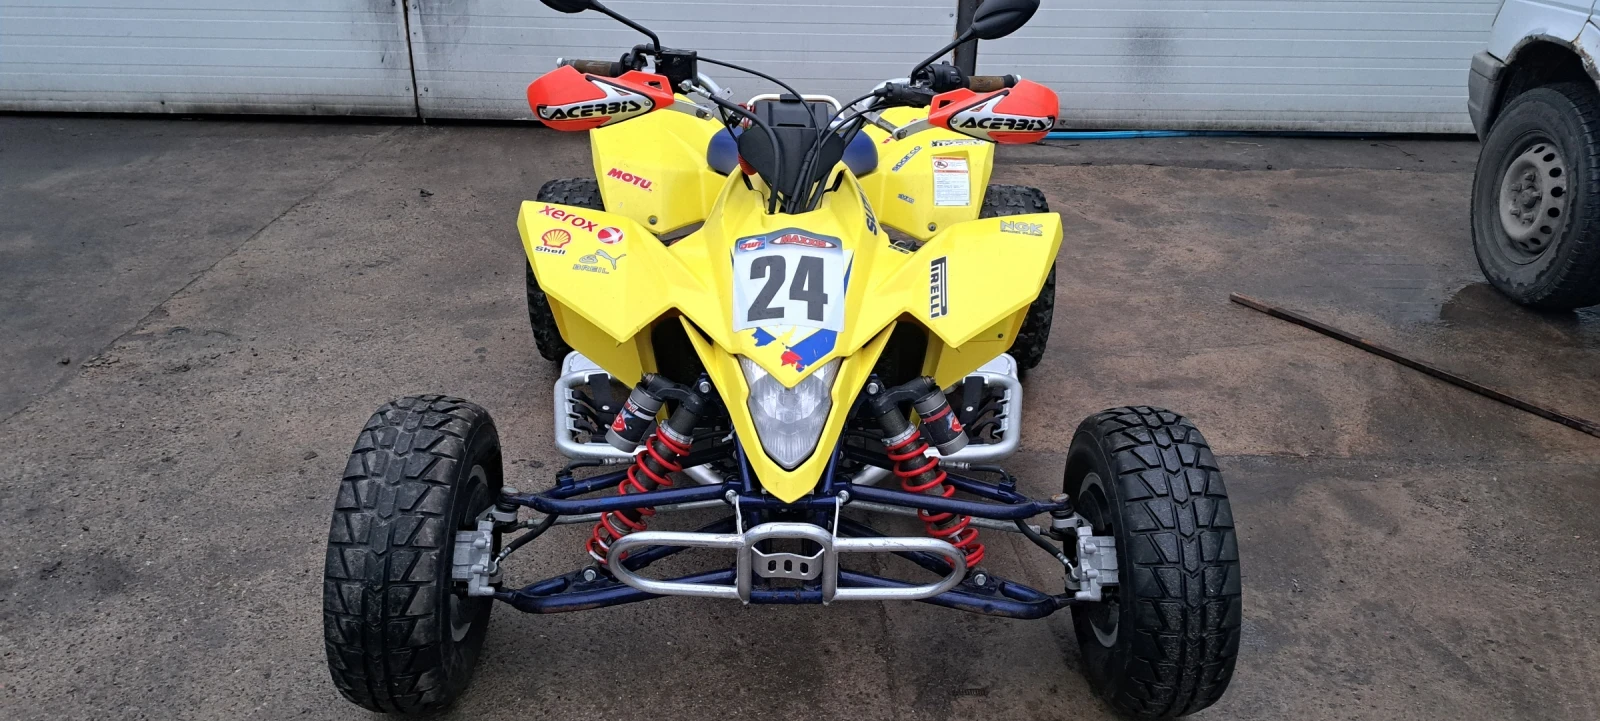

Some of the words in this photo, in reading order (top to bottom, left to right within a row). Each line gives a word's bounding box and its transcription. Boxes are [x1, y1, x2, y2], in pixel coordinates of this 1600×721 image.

[550, 100, 642, 120] ACERBIS
[960, 116, 1047, 131] ACERBIS
[538, 205, 598, 232] xerox
[1000, 220, 1043, 235] NGK
[780, 234, 826, 248] MAXXIS
[535, 245, 566, 255] Shell
[572, 263, 610, 275] BREIL
[747, 254, 828, 322] 24
[930, 256, 948, 319] PIRELLI
